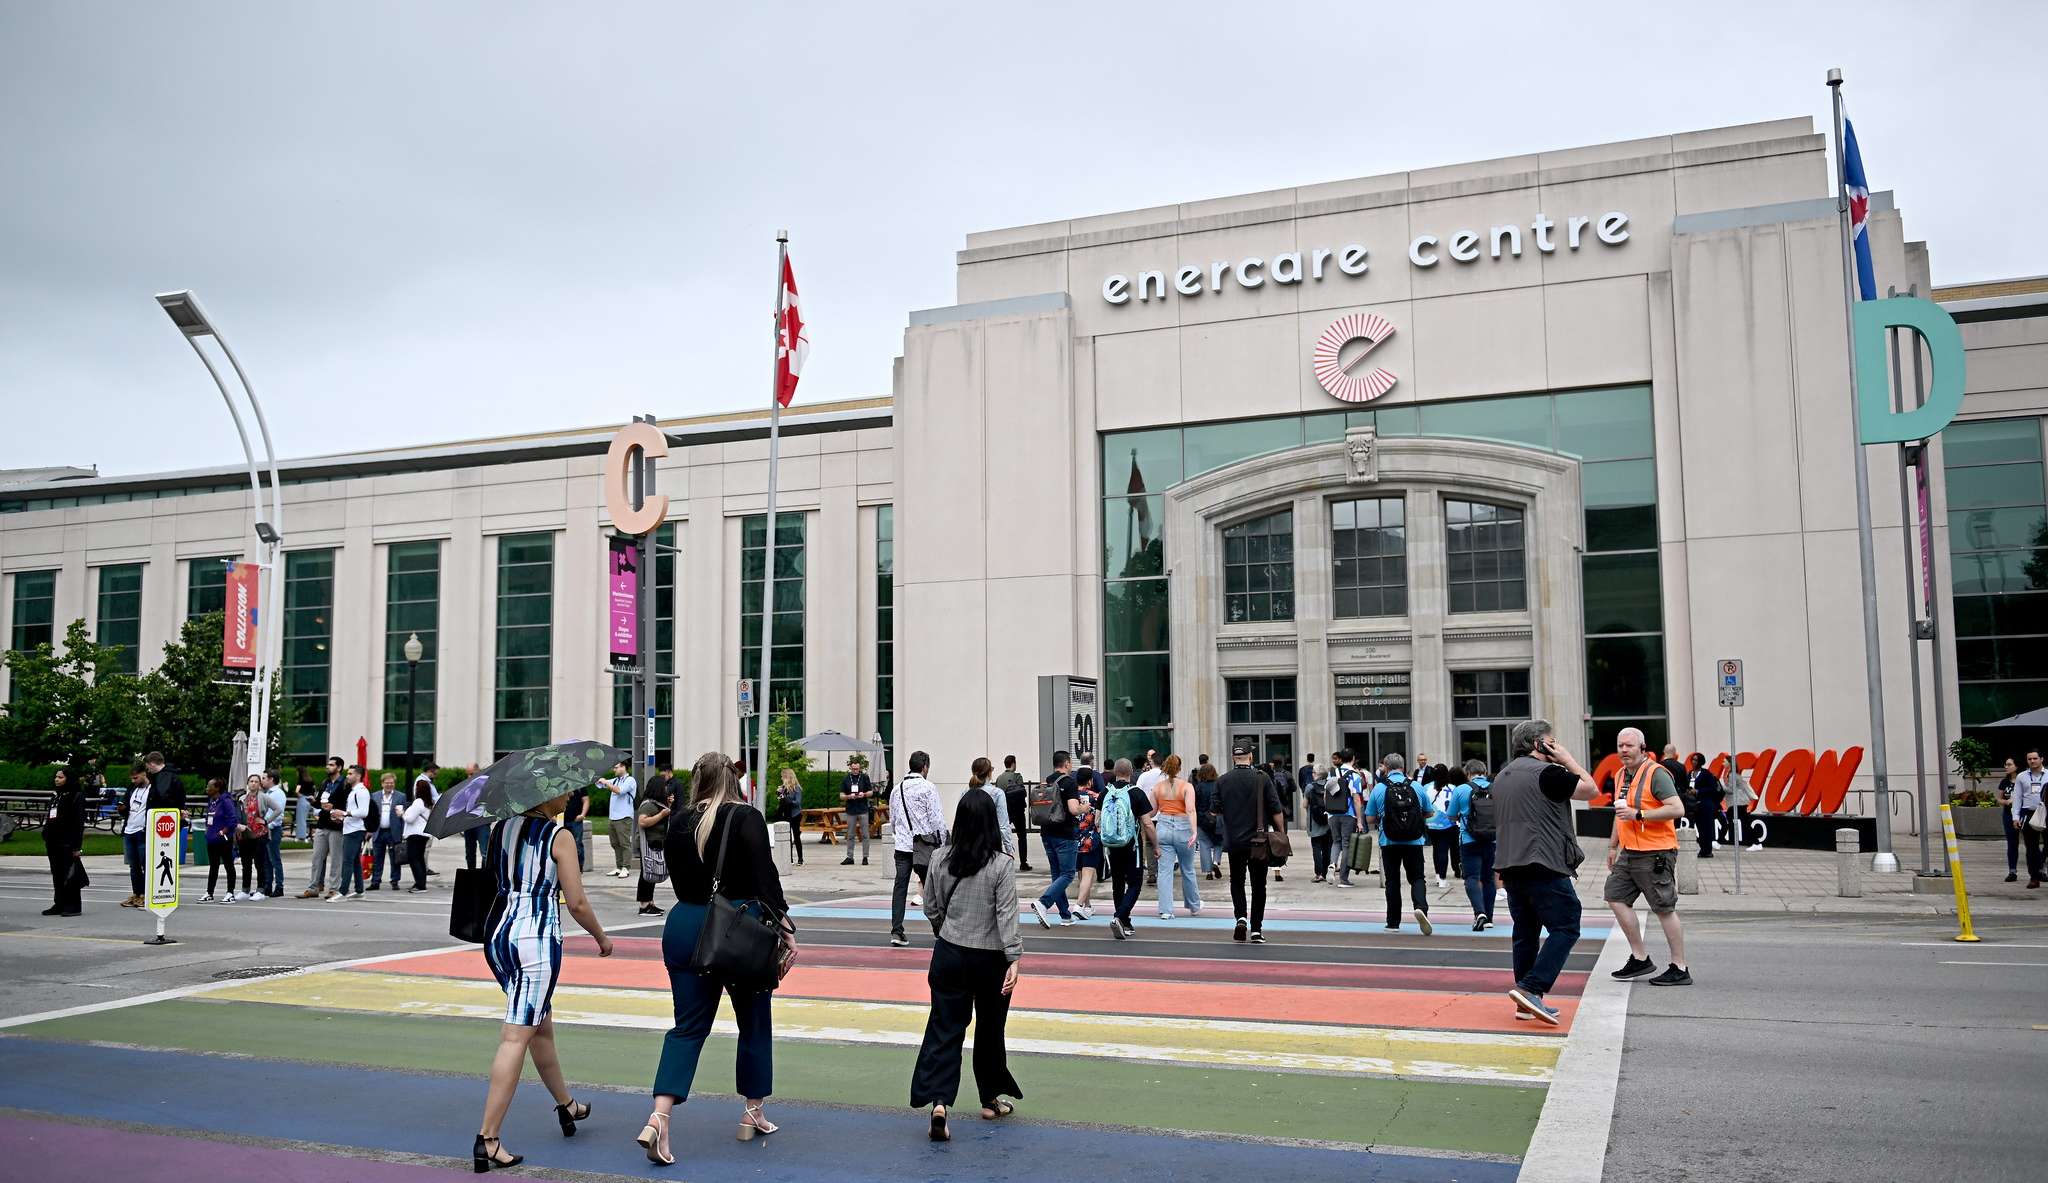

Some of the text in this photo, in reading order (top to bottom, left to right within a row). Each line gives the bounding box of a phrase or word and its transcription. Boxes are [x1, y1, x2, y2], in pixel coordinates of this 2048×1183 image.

[1102, 210, 1632, 305] enercare centre
[1853, 297, 1967, 445] D
[607, 422, 670, 535] C
[235, 583, 248, 650] COLLISION
[1337, 674, 1408, 685] Exhibit Halls
[1362, 686, 1383, 696] C D
[1074, 713, 1094, 760] 30
[157, 822, 175, 832] STOP
